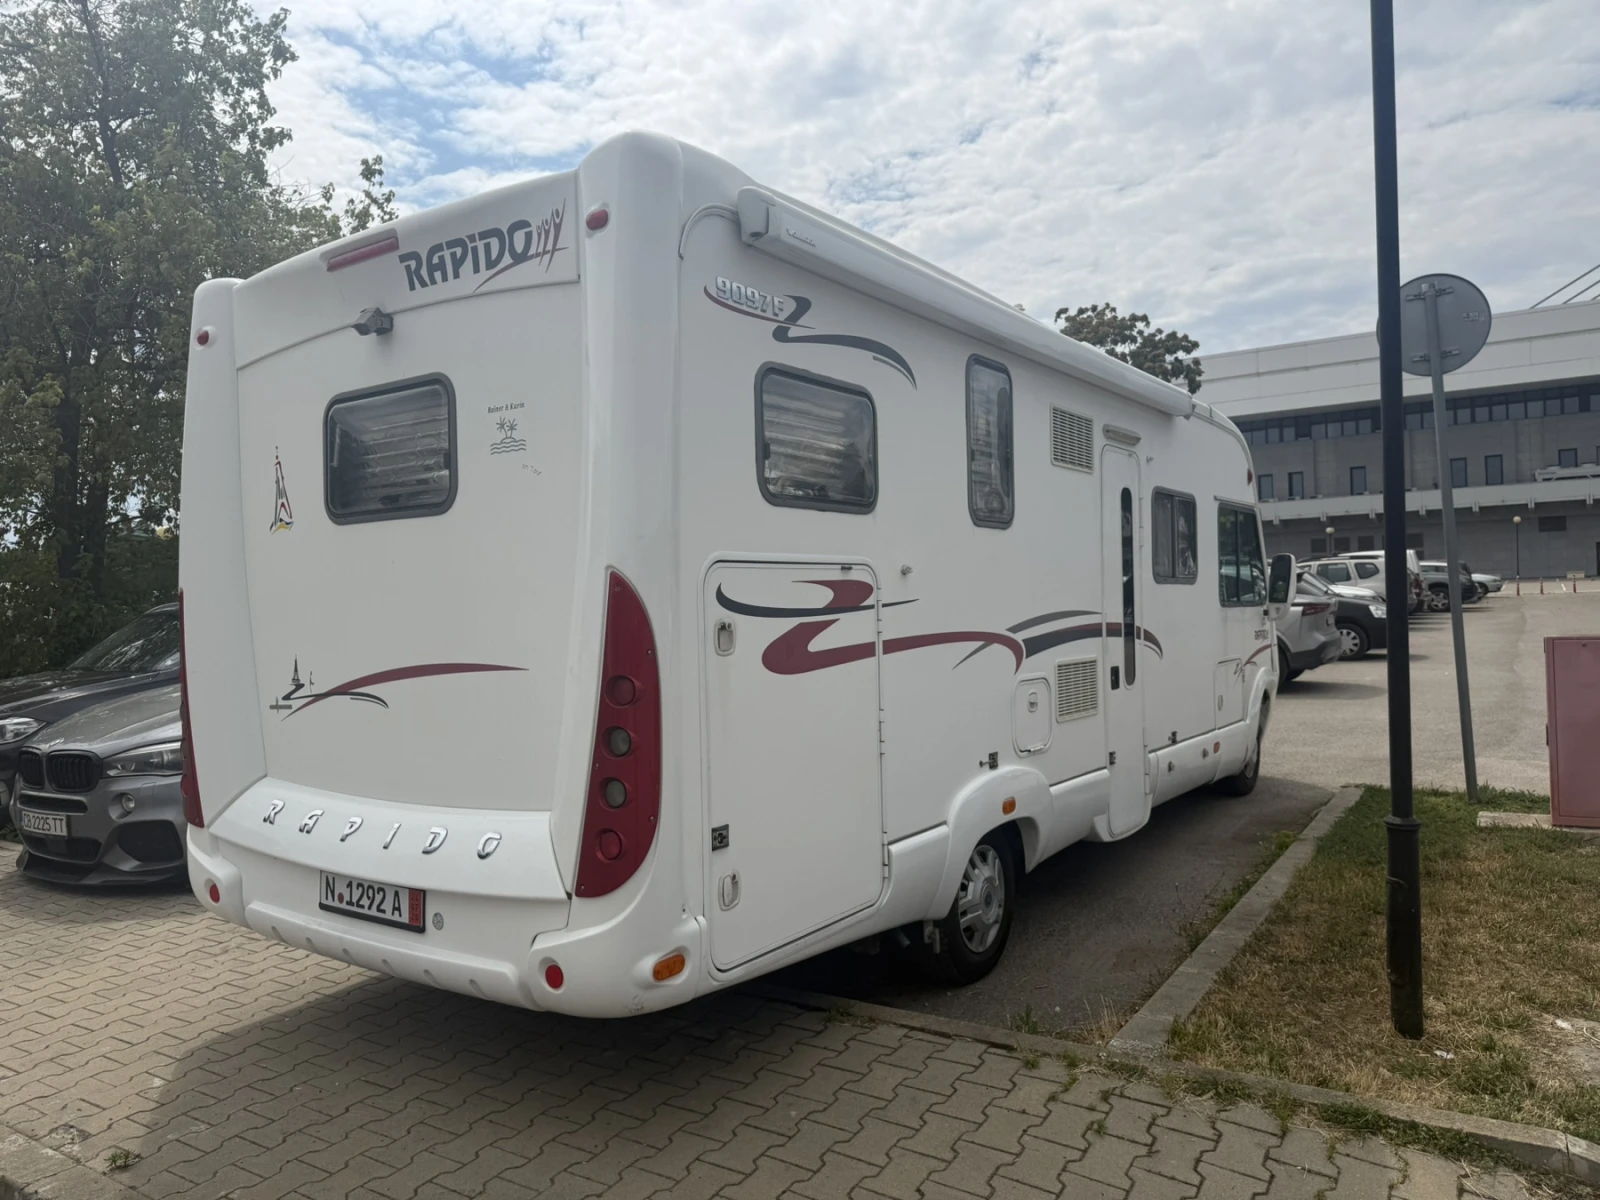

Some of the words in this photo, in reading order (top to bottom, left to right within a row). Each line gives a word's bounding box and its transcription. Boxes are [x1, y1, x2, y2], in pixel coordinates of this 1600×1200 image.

[715, 275, 785, 317] 9097F
[52, 818, 63, 832] TT
[262, 799, 502, 860] RAPIDO
[325, 875, 336, 903] N
[345, 880, 387, 915] 1292
[391, 889, 403, 918] A
